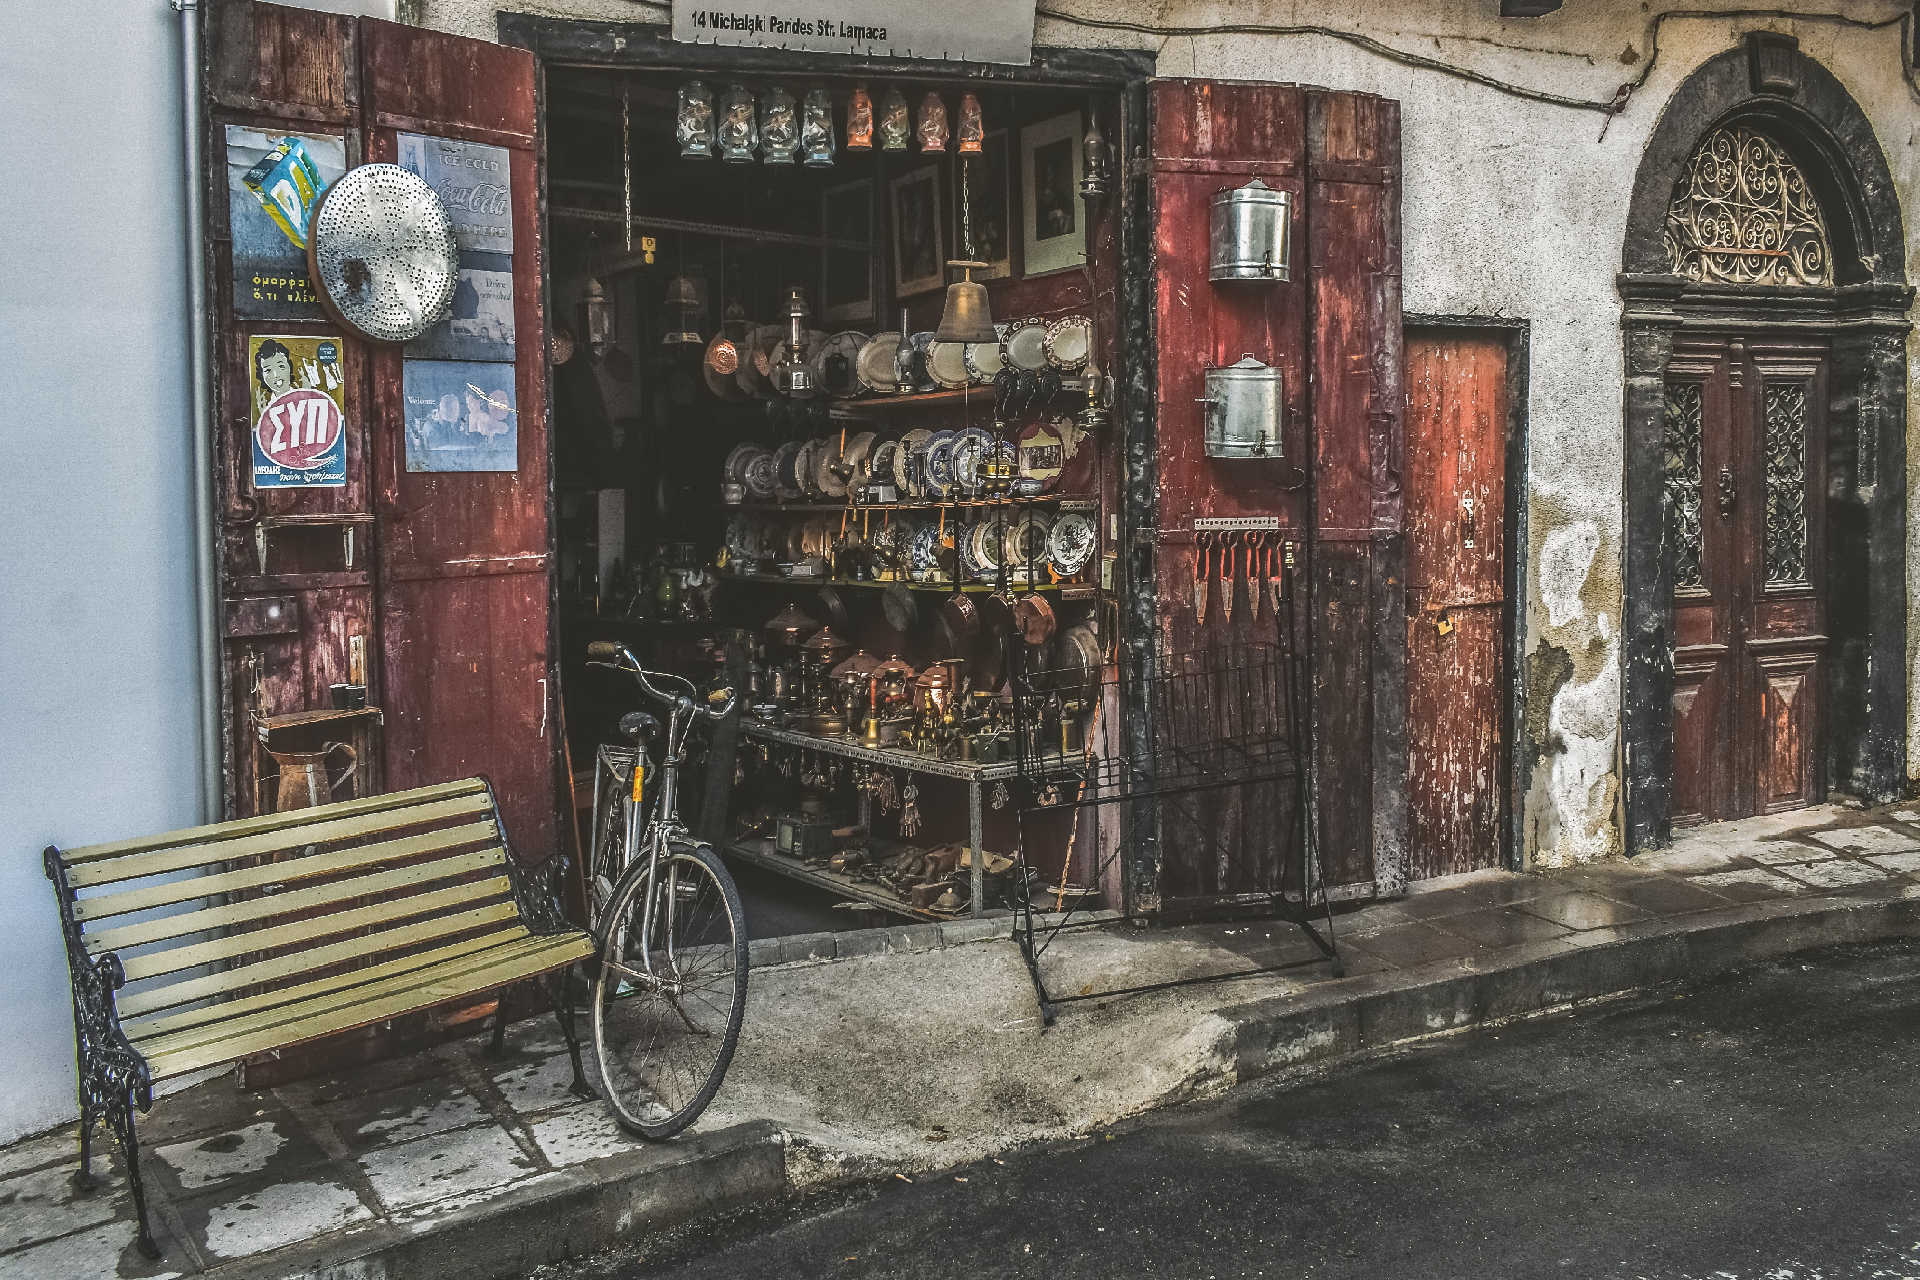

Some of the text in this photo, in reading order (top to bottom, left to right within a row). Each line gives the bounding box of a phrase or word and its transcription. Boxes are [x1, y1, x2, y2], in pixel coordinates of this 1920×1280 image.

[691, 10, 706, 28] 14
[709, 11, 766, 33] Michalaki
[769, 15, 814, 36] Parides
[816, 19, 836, 37] Str.
[440, 154, 499, 171] ICE COLD
[268, 398, 329, 455] ΣΥΠ
